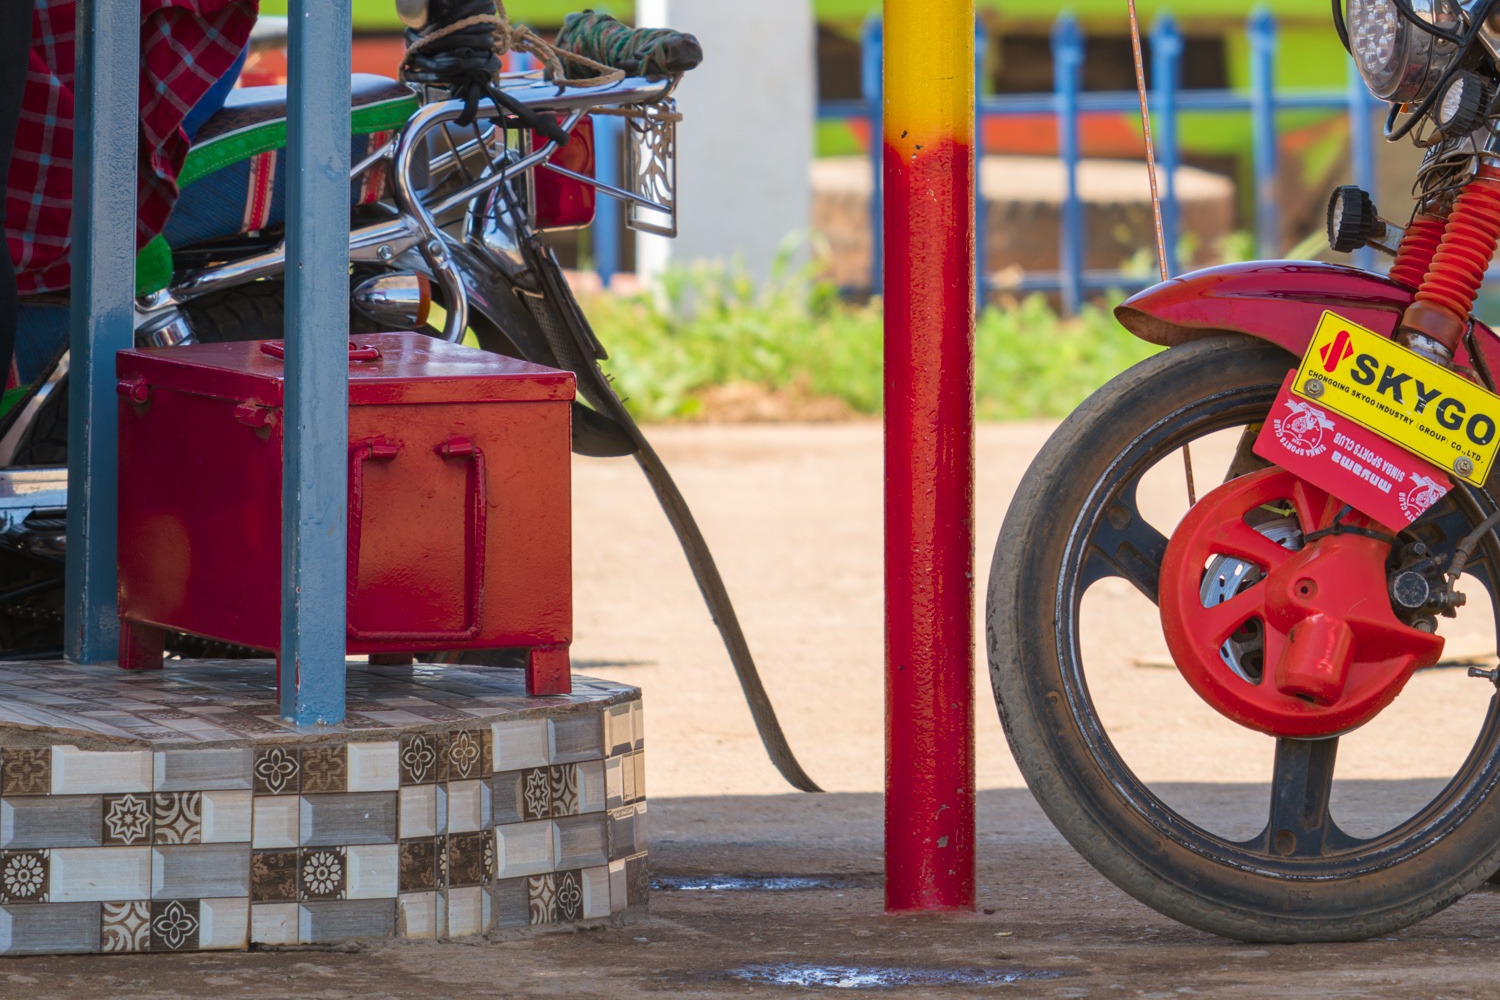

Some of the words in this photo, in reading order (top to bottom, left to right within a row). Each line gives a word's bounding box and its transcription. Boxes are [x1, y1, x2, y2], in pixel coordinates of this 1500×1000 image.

[1308, 369, 1350, 393] CHONGQING
[1351, 389, 1376, 406] SKYGO
[1376, 402, 1414, 425] INDUSTRY
[1350, 353, 1496, 446] SKYGO
[1333, 432, 1355, 451] CLUB
[1353, 443, 1383, 469] SPORTS
[1331, 450, 1393, 494] mnyama
[1381, 460, 1406, 482] SIMBA
